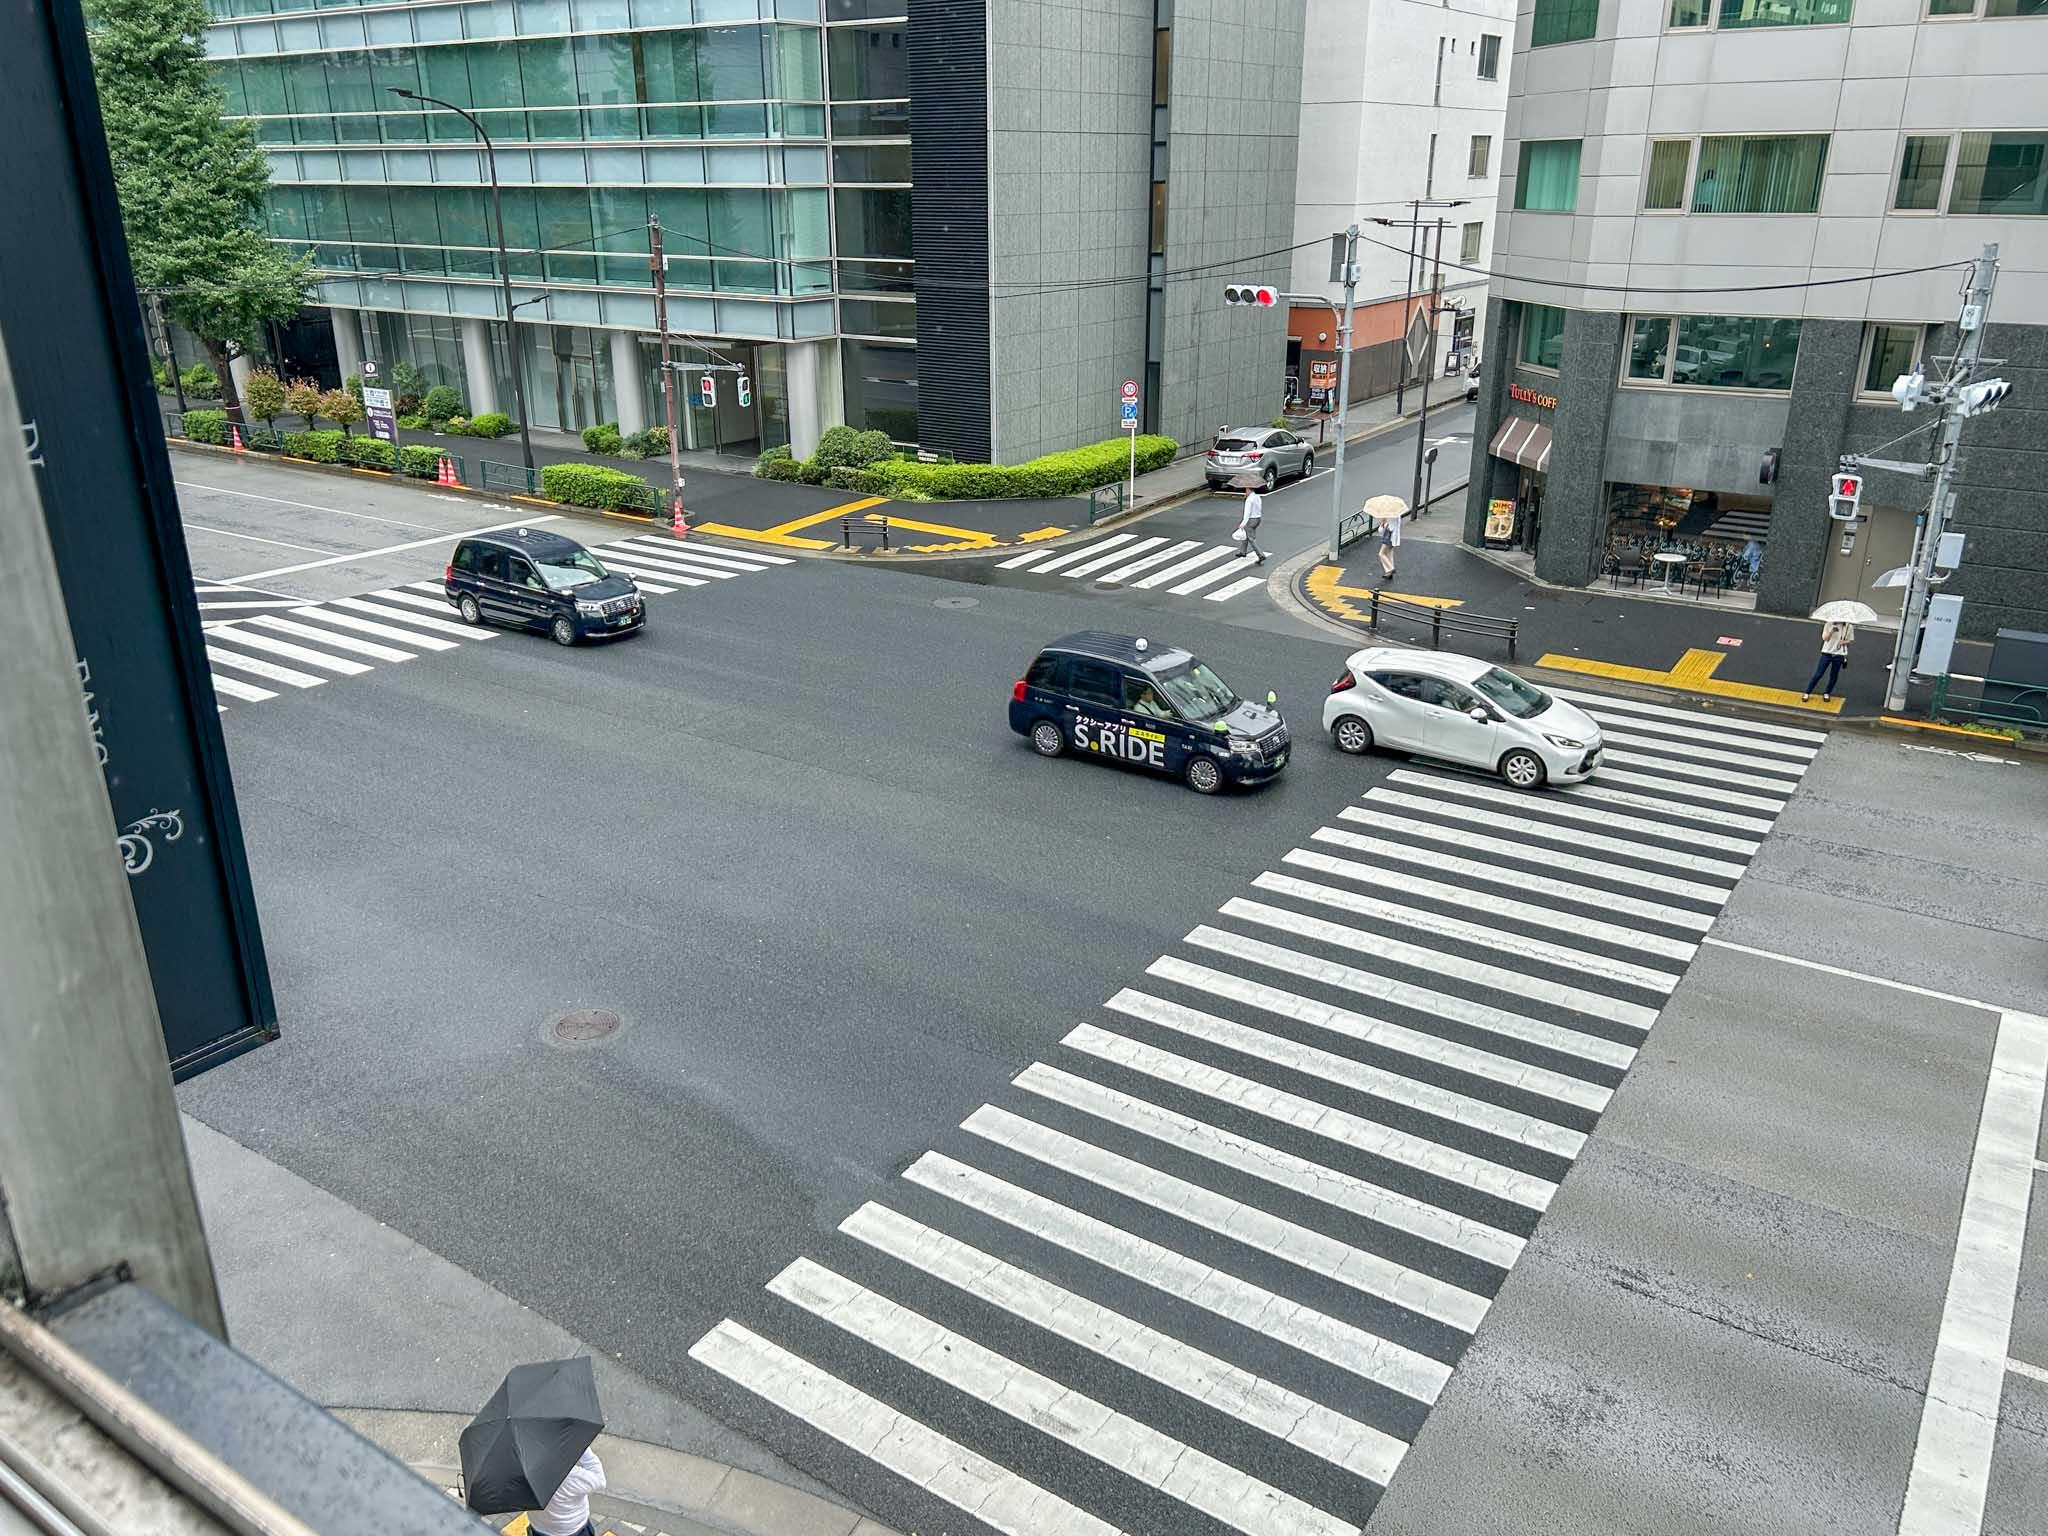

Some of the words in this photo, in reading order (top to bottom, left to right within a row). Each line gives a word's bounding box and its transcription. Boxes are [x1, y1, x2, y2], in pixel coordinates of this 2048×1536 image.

[1076, 715, 1126, 733] タクシーアプリ
[1074, 723, 1165, 767] S.RIDE
